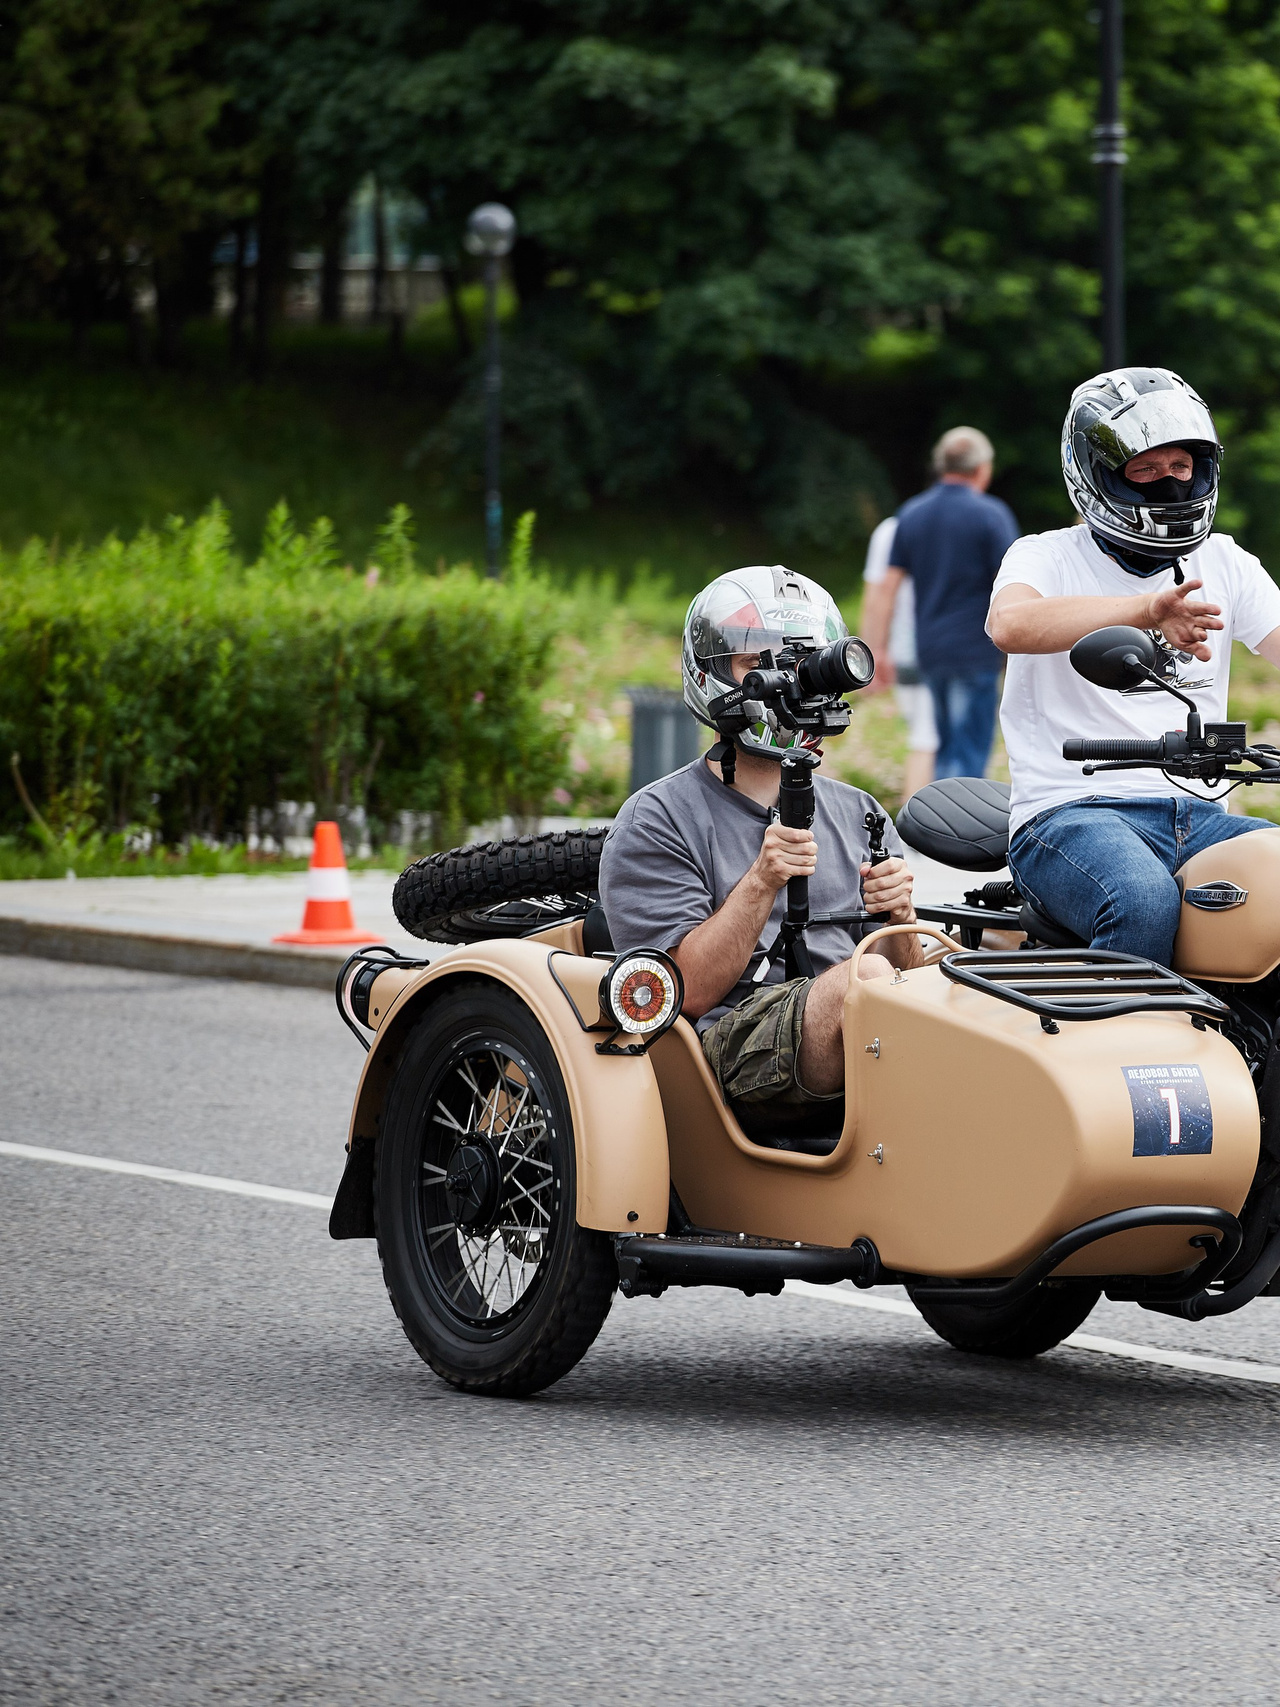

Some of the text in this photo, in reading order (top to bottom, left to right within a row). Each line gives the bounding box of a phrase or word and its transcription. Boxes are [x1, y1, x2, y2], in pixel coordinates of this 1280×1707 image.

[773, 608, 818, 623] Nitro
[723, 690, 744, 704] RONIN
[1127, 1067, 1200, 1080] ЛЕДОВАЯ БИТВА
[1159, 1087, 1180, 1144] 1
